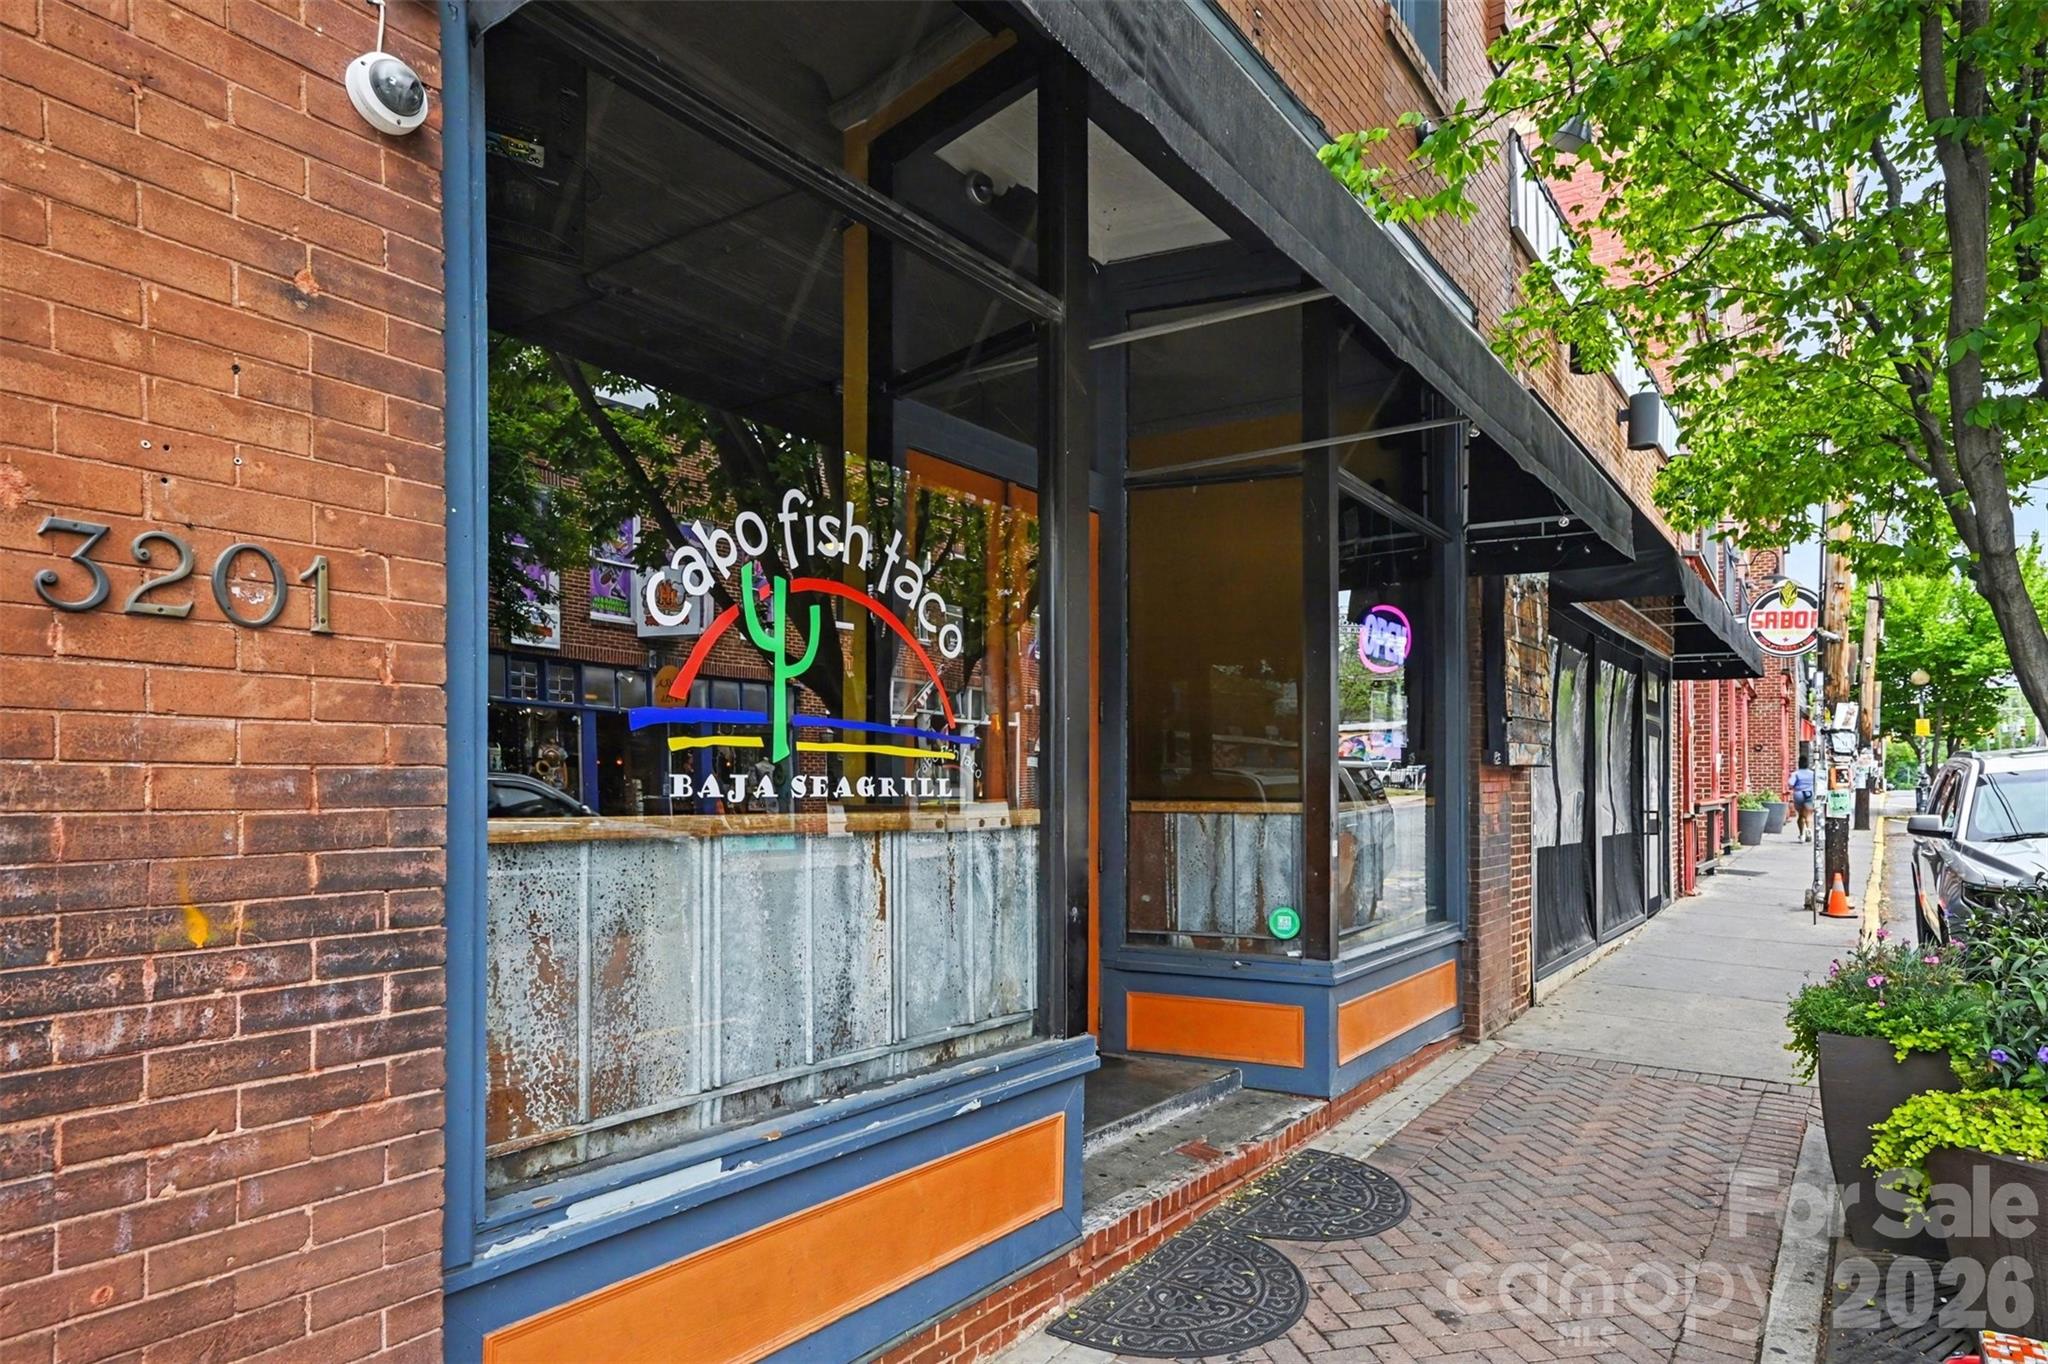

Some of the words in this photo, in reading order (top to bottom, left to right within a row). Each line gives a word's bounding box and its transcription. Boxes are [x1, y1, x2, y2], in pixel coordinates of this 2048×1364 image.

[34, 516, 333, 634] 3201
[646, 511, 768, 626] cabo
[777, 488, 869, 571] fish
[877, 529, 963, 659] taco
[1365, 613, 1407, 666] OPEN
[669, 774, 778, 803] BAJA
[790, 774, 953, 798] SEAGRILL
